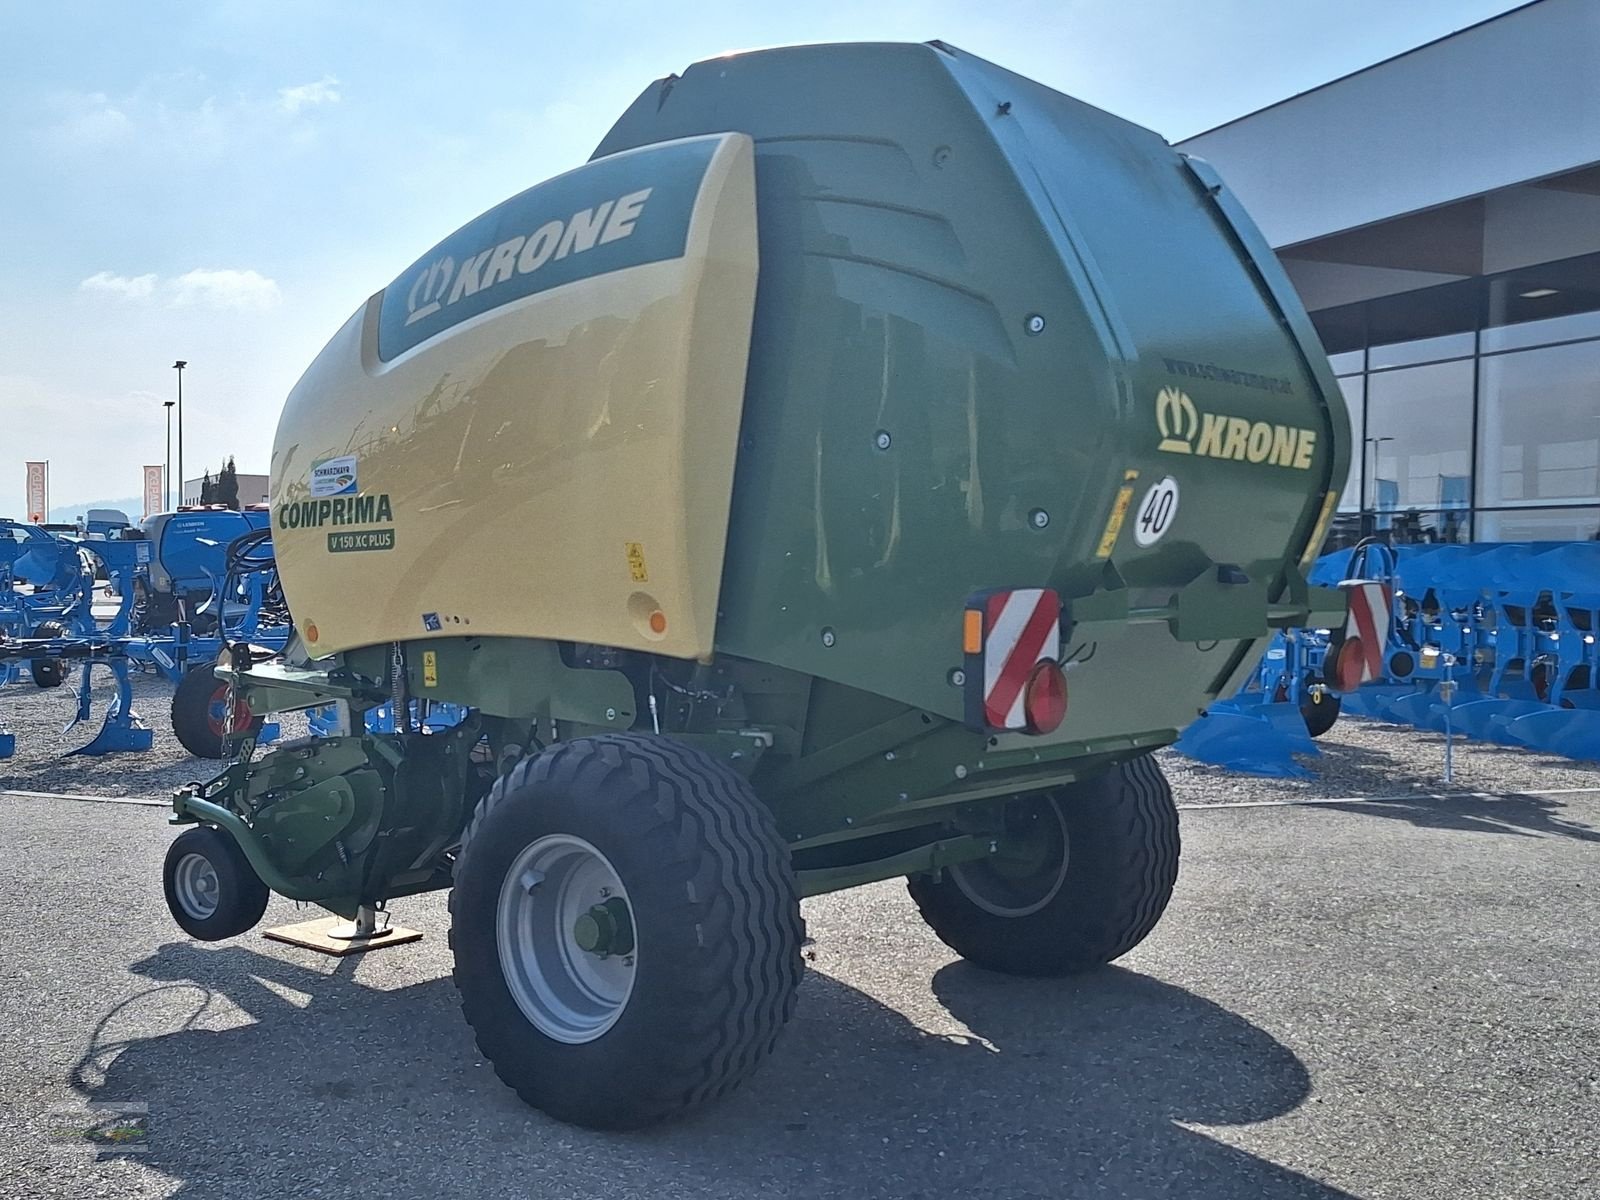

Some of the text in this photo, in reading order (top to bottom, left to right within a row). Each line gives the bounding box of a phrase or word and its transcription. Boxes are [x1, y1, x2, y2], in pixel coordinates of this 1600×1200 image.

[447, 187, 653, 305] KRONE
[1195, 413, 1316, 469] KRONE
[279, 494, 393, 529] COMPRIMA
[1140, 489, 1174, 534] 40
[331, 533, 391, 549] V 150 XC PLUS
